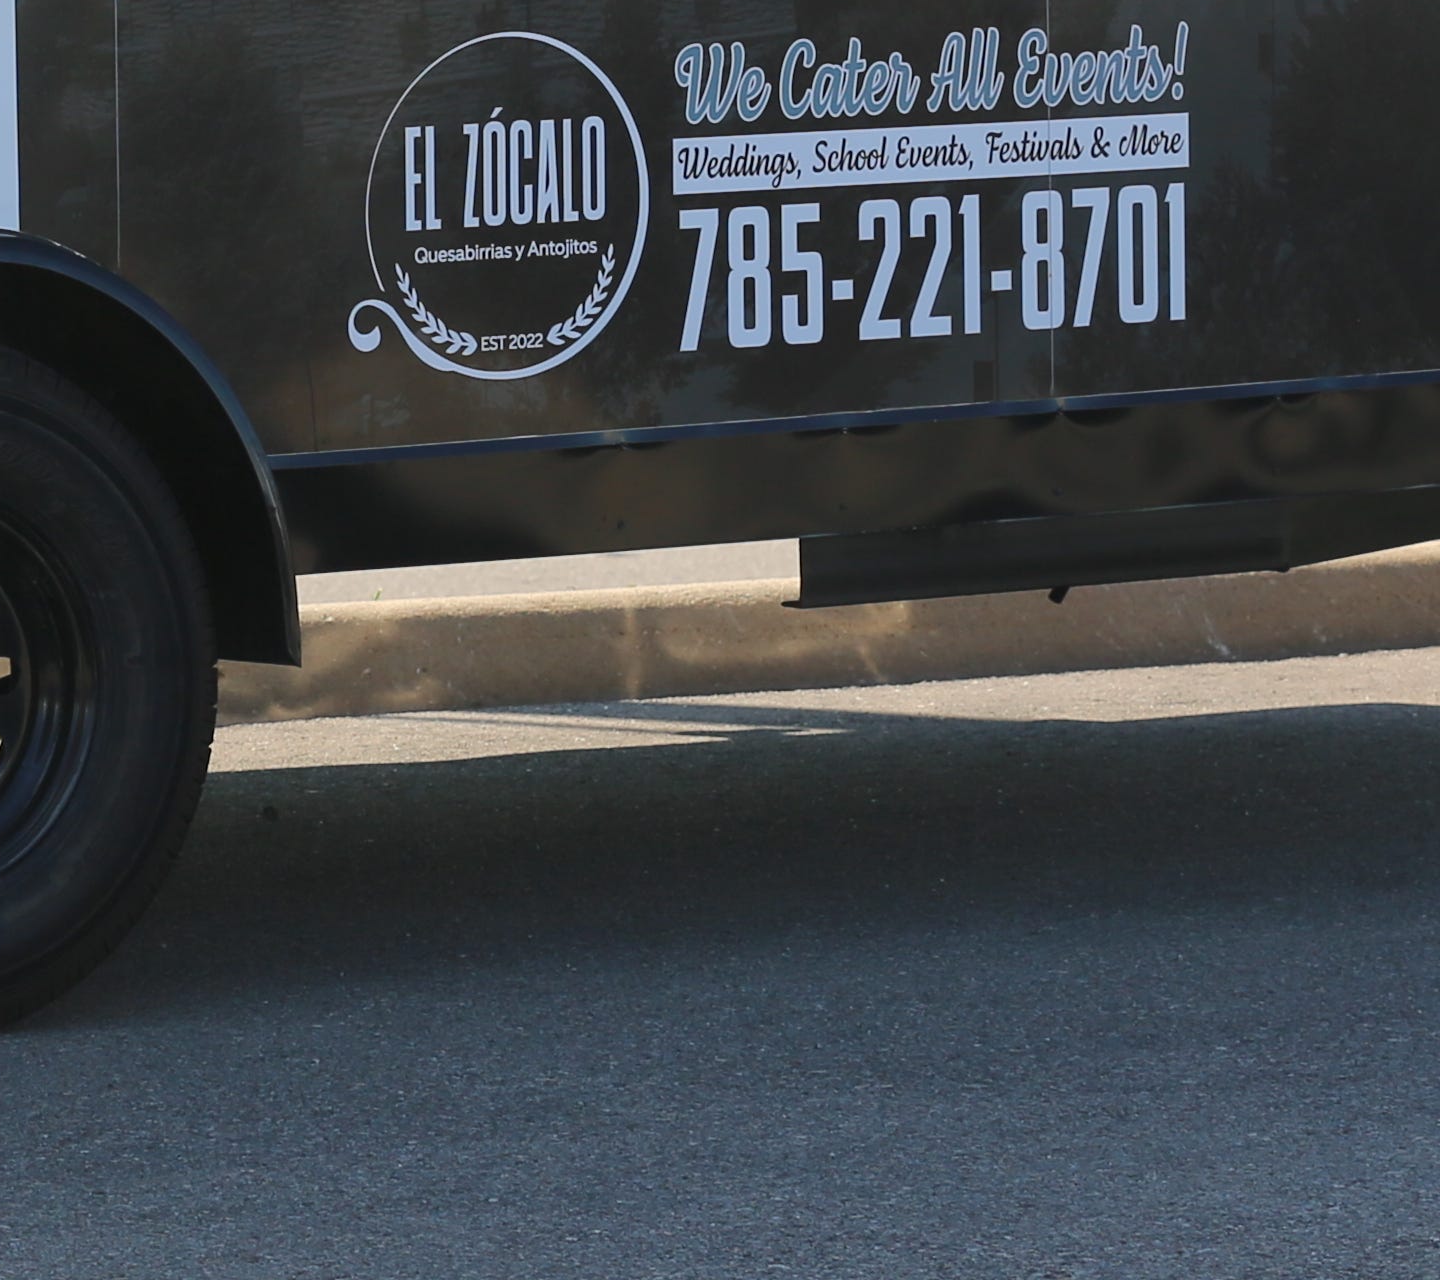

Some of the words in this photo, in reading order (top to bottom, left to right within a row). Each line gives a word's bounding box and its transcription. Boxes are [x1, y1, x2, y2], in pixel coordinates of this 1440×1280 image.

[675, 42, 771, 124] We
[779, 37, 920, 120] Cater
[927, 27, 1004, 113] All
[1014, 21, 1189, 108] Events!
[405, 125, 441, 231] EL
[463, 107, 606, 228] ZÓCALO
[678, 143, 802, 188] Weddings,
[813, 136, 889, 173] School
[895, 134, 974, 172] Events,
[986, 127, 1084, 164] Festivals
[1091, 127, 1110, 157] &
[1119, 124, 1183, 157] More
[414, 244, 512, 264] Quesabirrias
[515, 246, 524, 261] y
[527, 239, 598, 258] Antojitos
[679, 182, 1187, 354] 785-221-8701
[481, 336, 506, 351] EST
[509, 334, 543, 350] 2022
